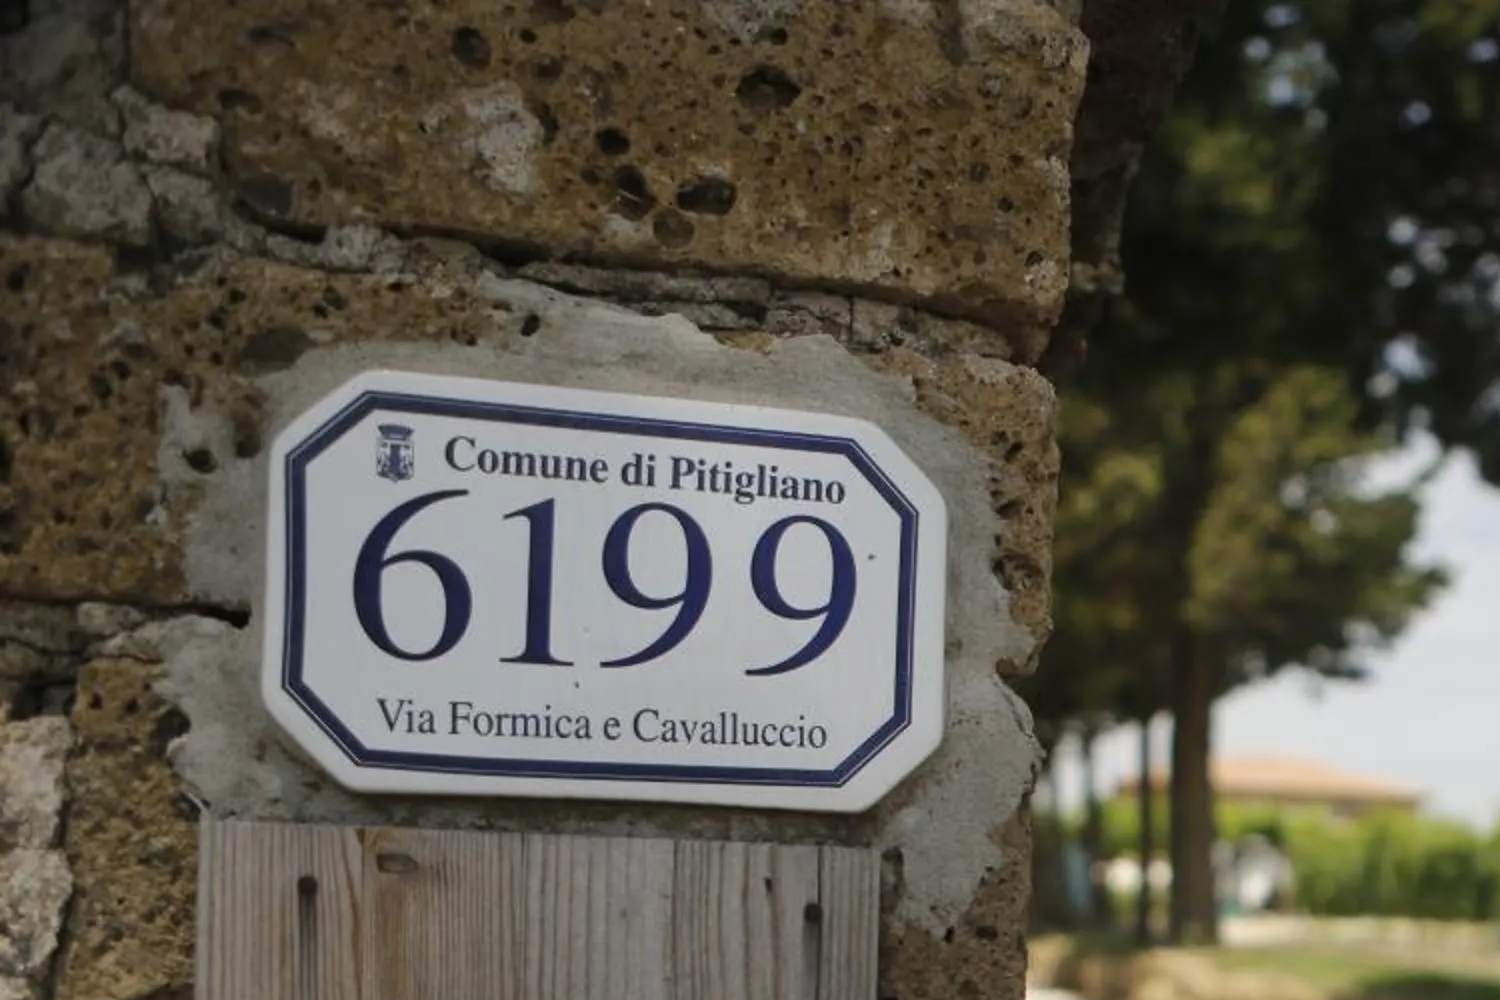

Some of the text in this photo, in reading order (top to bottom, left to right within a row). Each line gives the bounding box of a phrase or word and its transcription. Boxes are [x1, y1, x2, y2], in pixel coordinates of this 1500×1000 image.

[444, 434, 846, 505] Comune di Pitigliano
[353, 488, 857, 677] 6199
[377, 698, 828, 749] Via Formica e Cavalluccio
